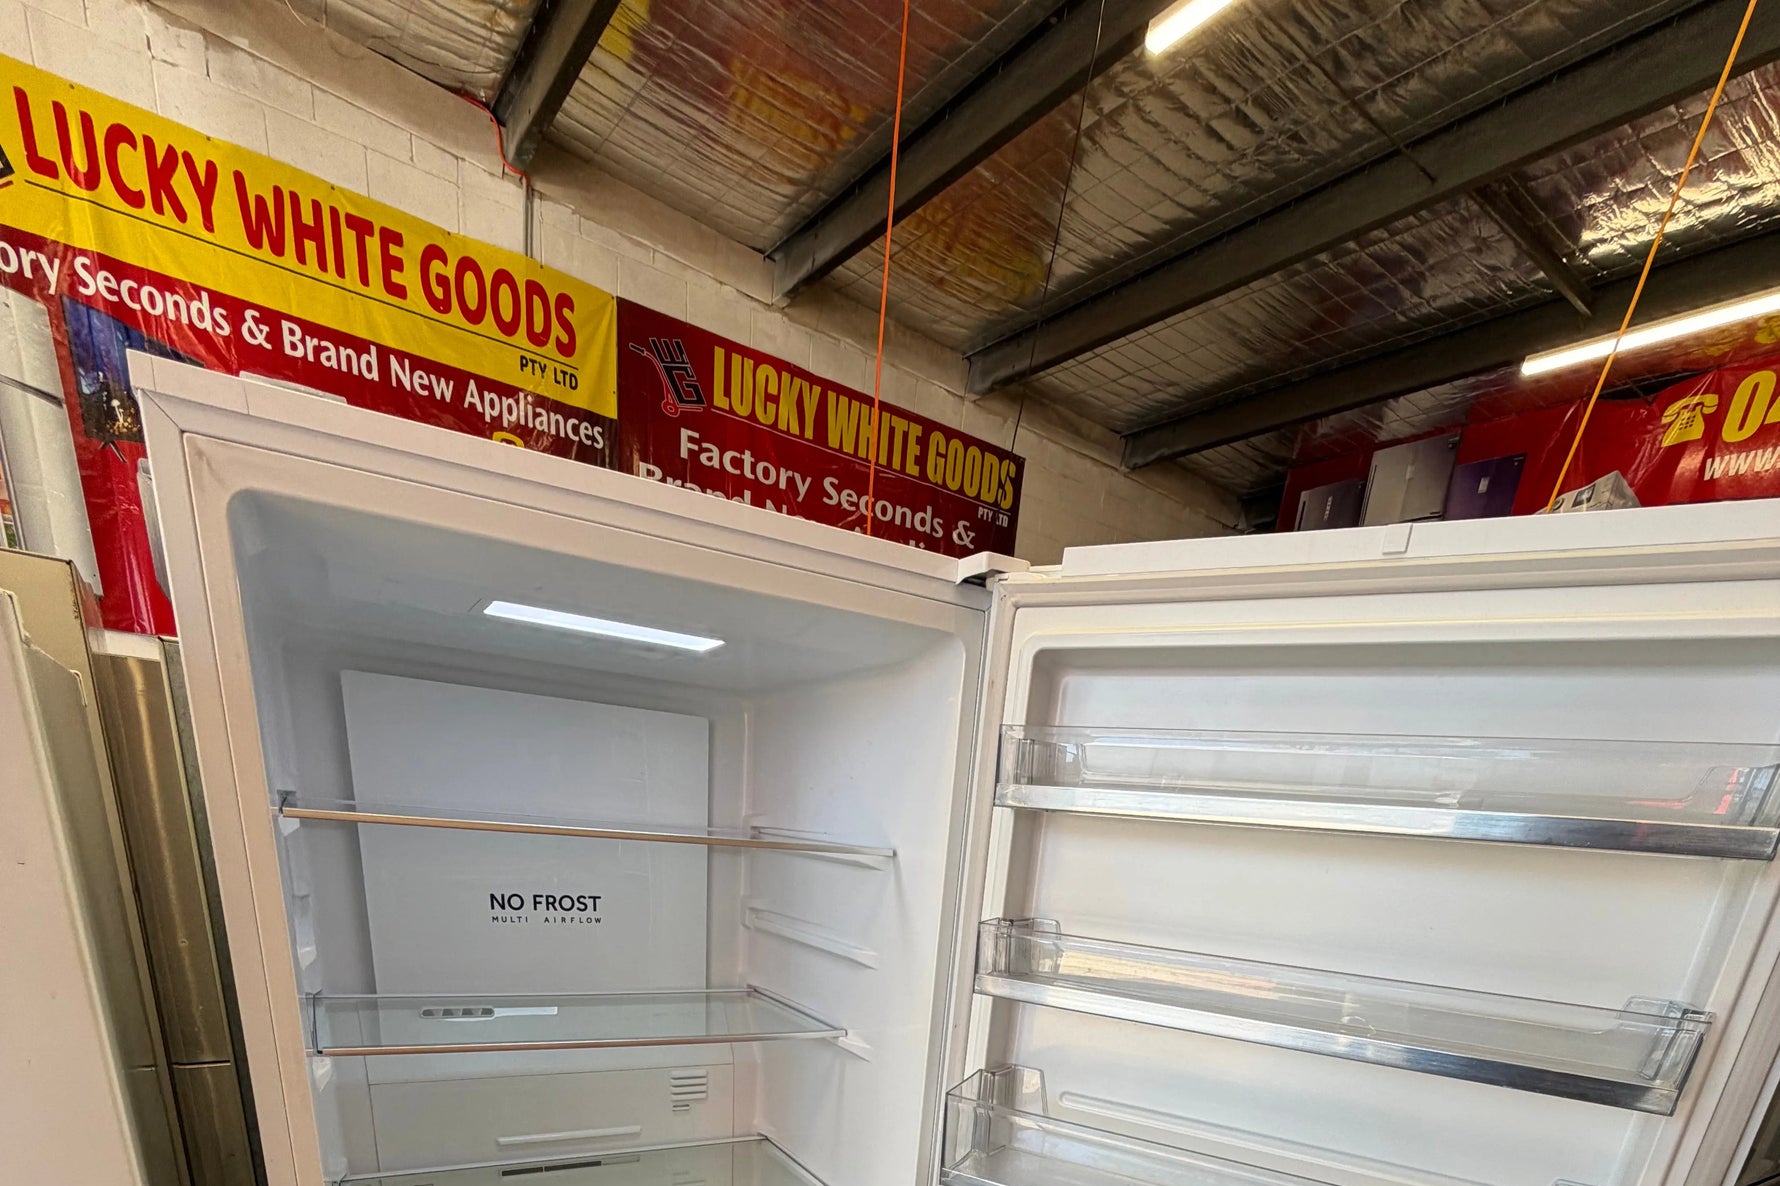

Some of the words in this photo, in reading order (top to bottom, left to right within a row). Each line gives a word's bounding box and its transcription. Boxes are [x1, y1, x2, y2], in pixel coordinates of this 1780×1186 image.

[13, 86, 219, 234] LUCKY
[233, 170, 407, 300] WHITE
[420, 244, 577, 358] GOODS
[74, 256, 231, 336] Seconds
[240, 308, 273, 350] &
[282, 320, 379, 382] Brand
[390, 361, 455, 403] New
[463, 380, 604, 449] Appliances
[520, 355, 549, 379] PTY
[553, 367, 579, 391] LTD
[713, 345, 821, 440] LUCKY
[827, 390, 921, 477] WHITE
[927, 431, 1016, 510] GOODS
[680, 427, 810, 502] Factory
[822, 476, 944, 538] Seconds
[952, 520, 976, 549] &
[978, 506, 993, 522] PTY
[490, 893, 525, 911] NO
[532, 894, 602, 912] FROST
[544, 916, 602, 924] AIRFLOW
